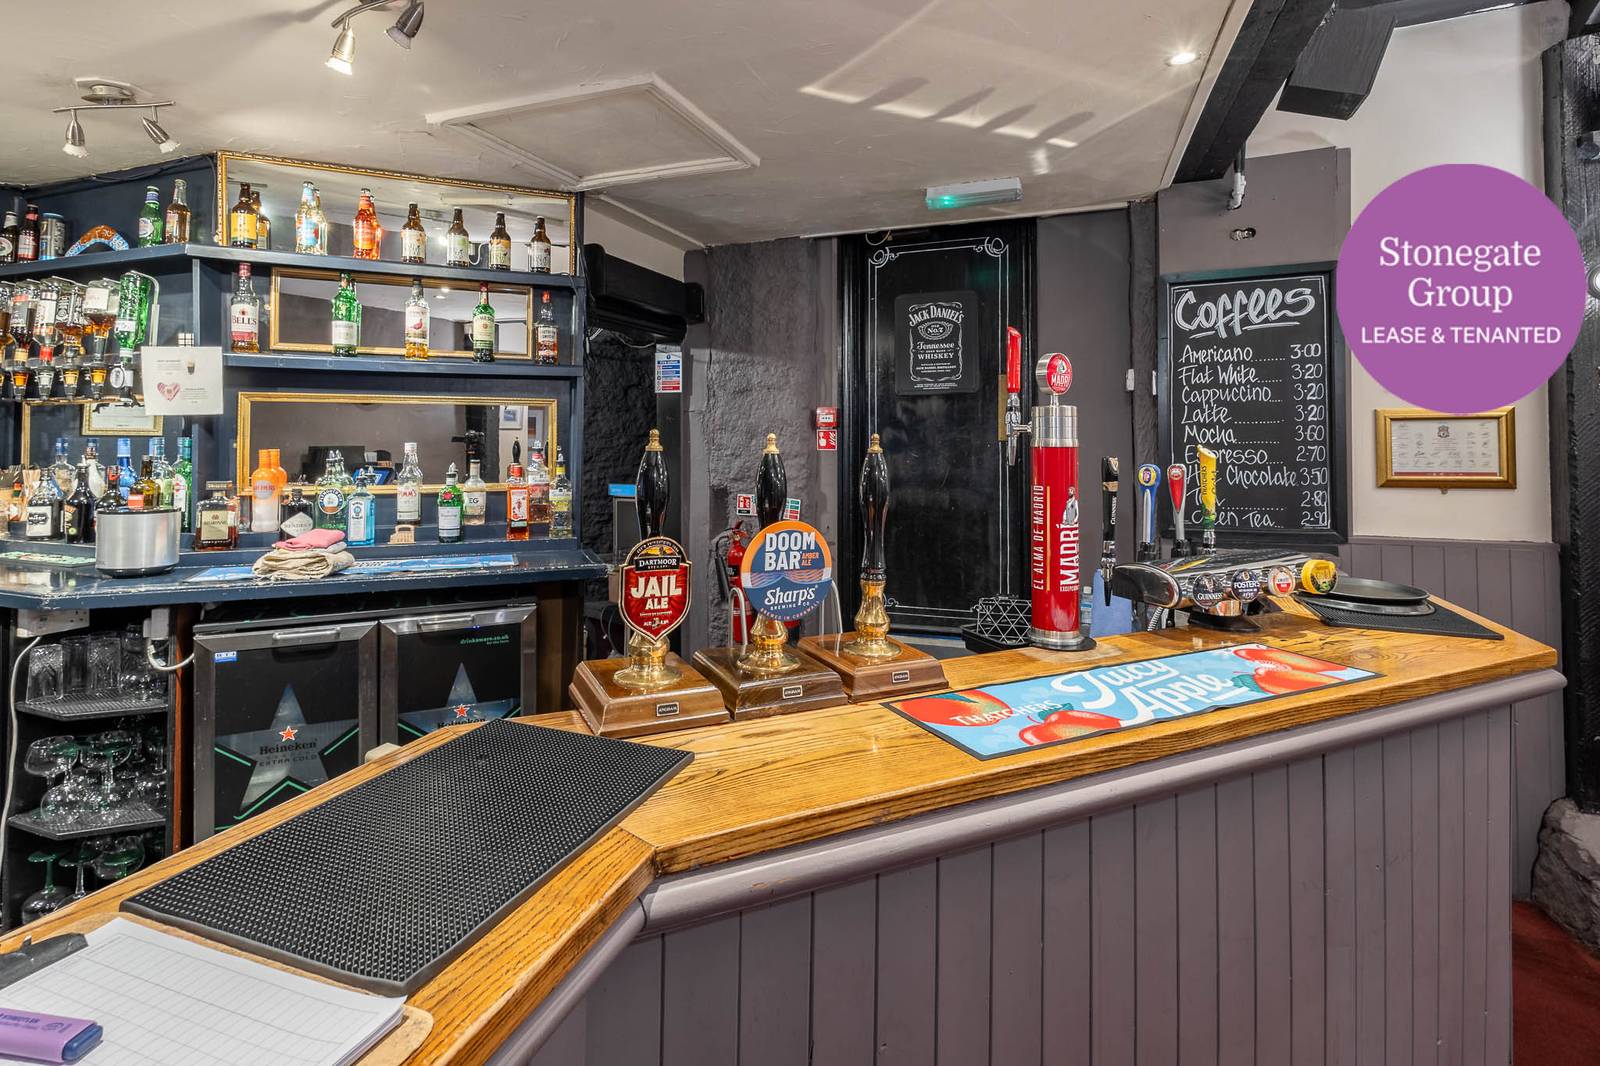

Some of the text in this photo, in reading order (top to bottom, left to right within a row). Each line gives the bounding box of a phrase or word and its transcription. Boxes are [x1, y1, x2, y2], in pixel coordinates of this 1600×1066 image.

[909, 305, 964, 327] JACK DANIEL'S
[1174, 288, 1316, 339] Coffees
[916, 341, 955, 350] Tennessee
[917, 352, 955, 360] WHISKEY
[1178, 345, 1253, 364] Americano
[1177, 365, 1214, 385] Flat
[1217, 363, 1259, 385] White
[1181, 385, 1272, 408] Cappuccino
[1181, 403, 1232, 424] Latte
[1183, 425, 1236, 446] Mocha
[1226, 465, 1298, 489] Chocolate
[1242, 511, 1276, 528] Tea
[765, 531, 816, 552] DOOM
[1033, 485, 1044, 591] EL ALMA DE MADRID
[639, 558, 677, 568] DARTMOOR
[764, 551, 800, 572] BAR
[801, 552, 820, 560] AMBER
[630, 574, 683, 599] JAIL
[764, 584, 816, 606] Sharp's
[645, 597, 669, 610] ALE
[1050, 659, 1180, 710] Juicy
[1119, 672, 1233, 728] Apple
[950, 699, 1064, 727] THATCHERS
[259, 741, 317, 755] Heineken
